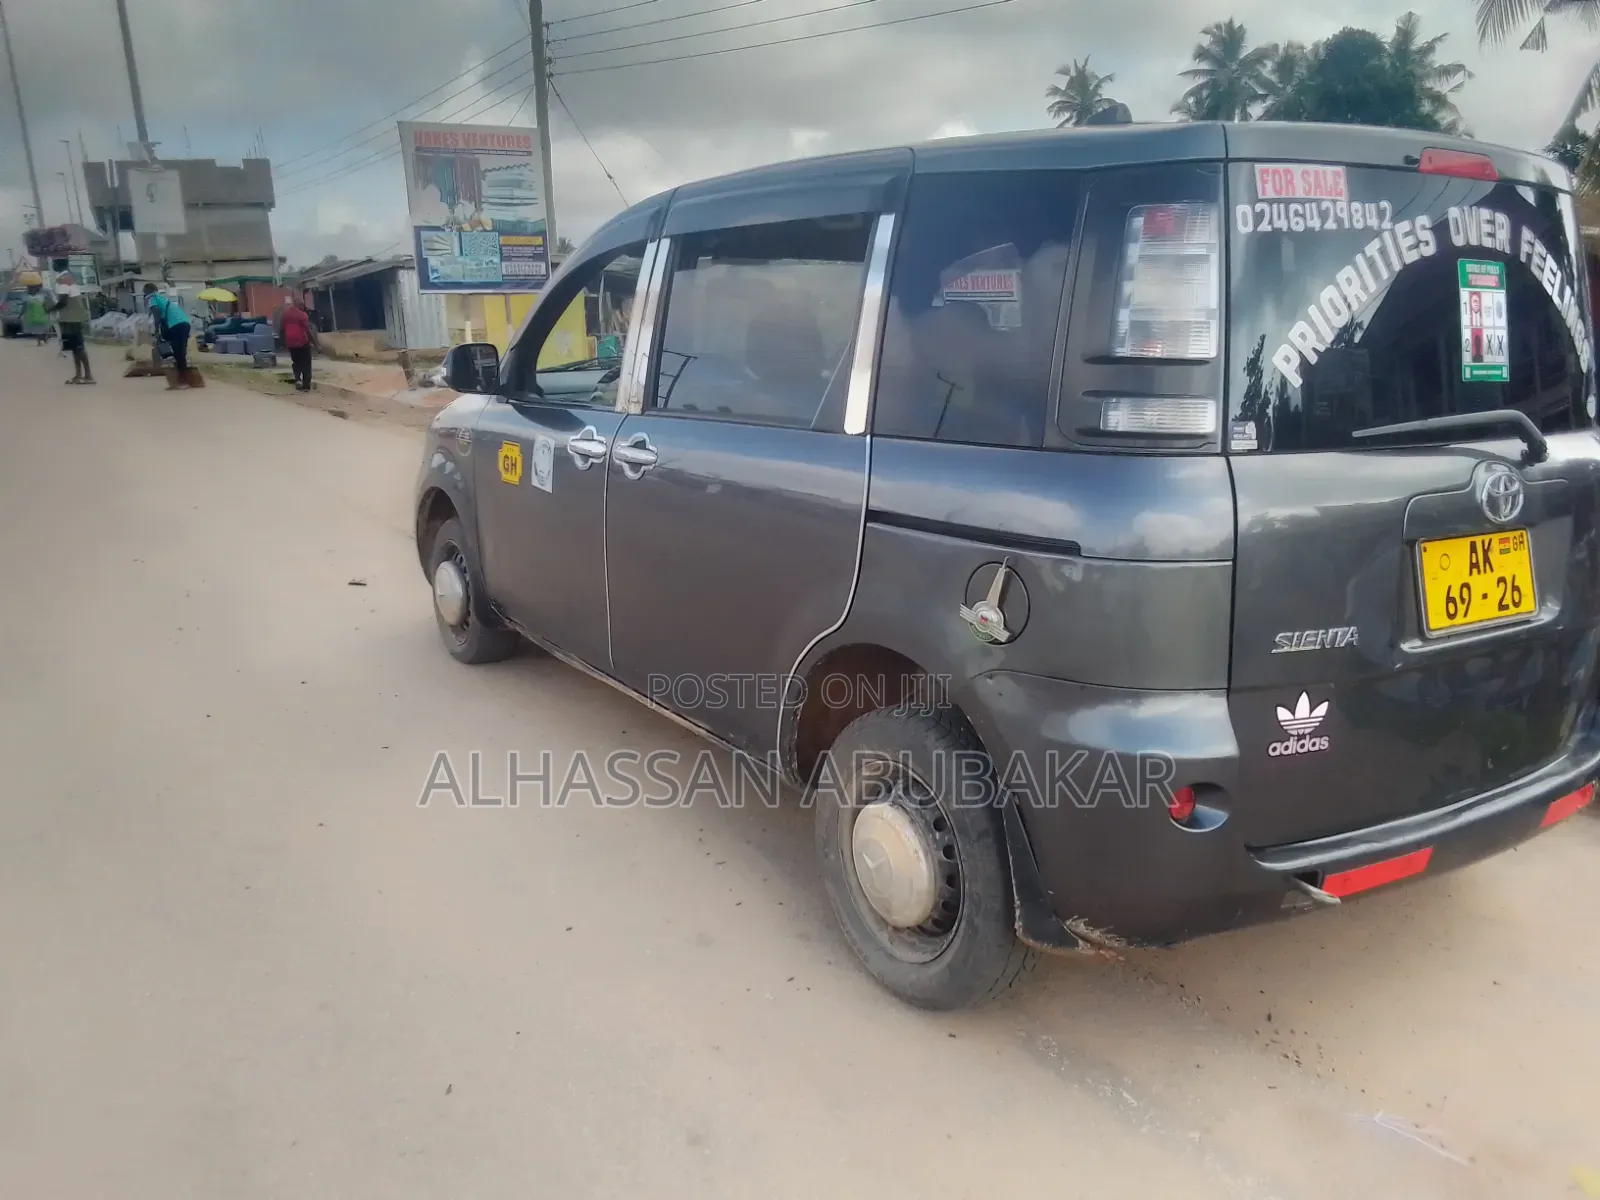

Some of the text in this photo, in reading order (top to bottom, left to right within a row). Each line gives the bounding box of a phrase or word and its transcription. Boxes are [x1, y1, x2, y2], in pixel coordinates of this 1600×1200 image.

[461, 133, 532, 149] VENTURES
[1259, 168, 1344, 197] FOR SALE
[1235, 200, 1393, 234] 0246429842
[1272, 214, 1437, 388] PRIORITIES
[1448, 206, 1511, 254] OVER
[1464, 338, 1471, 353] 2
[503, 454, 518, 476] GH
[1512, 532, 1526, 552] GH
[1468, 538, 1494, 576] AK
[1270, 626, 1359, 654] SIENTA
[1268, 735, 1330, 757] adidas
